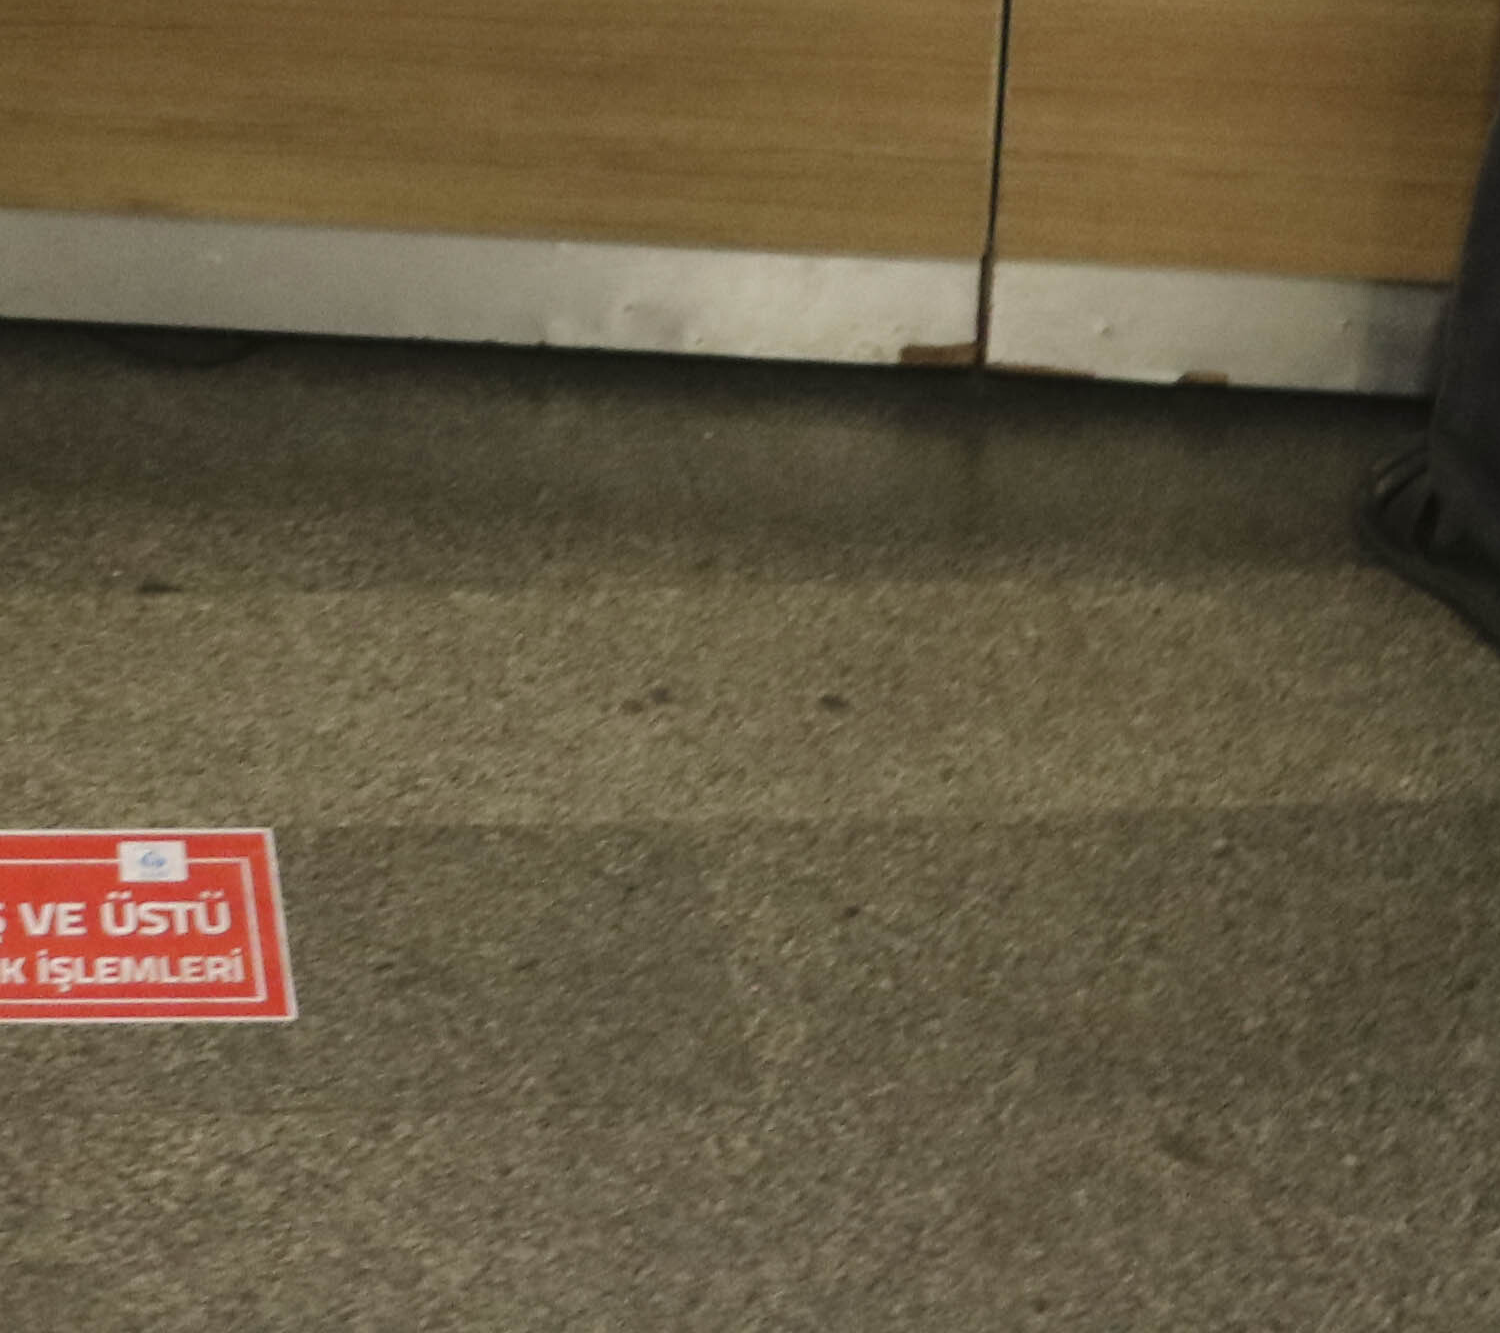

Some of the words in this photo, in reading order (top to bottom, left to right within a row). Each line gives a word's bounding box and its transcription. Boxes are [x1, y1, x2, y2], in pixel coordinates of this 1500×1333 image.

[16, 901, 88, 937] VE
[100, 890, 232, 936] ÜSTÜ
[36, 947, 245, 993] İŞLEMLERİ
